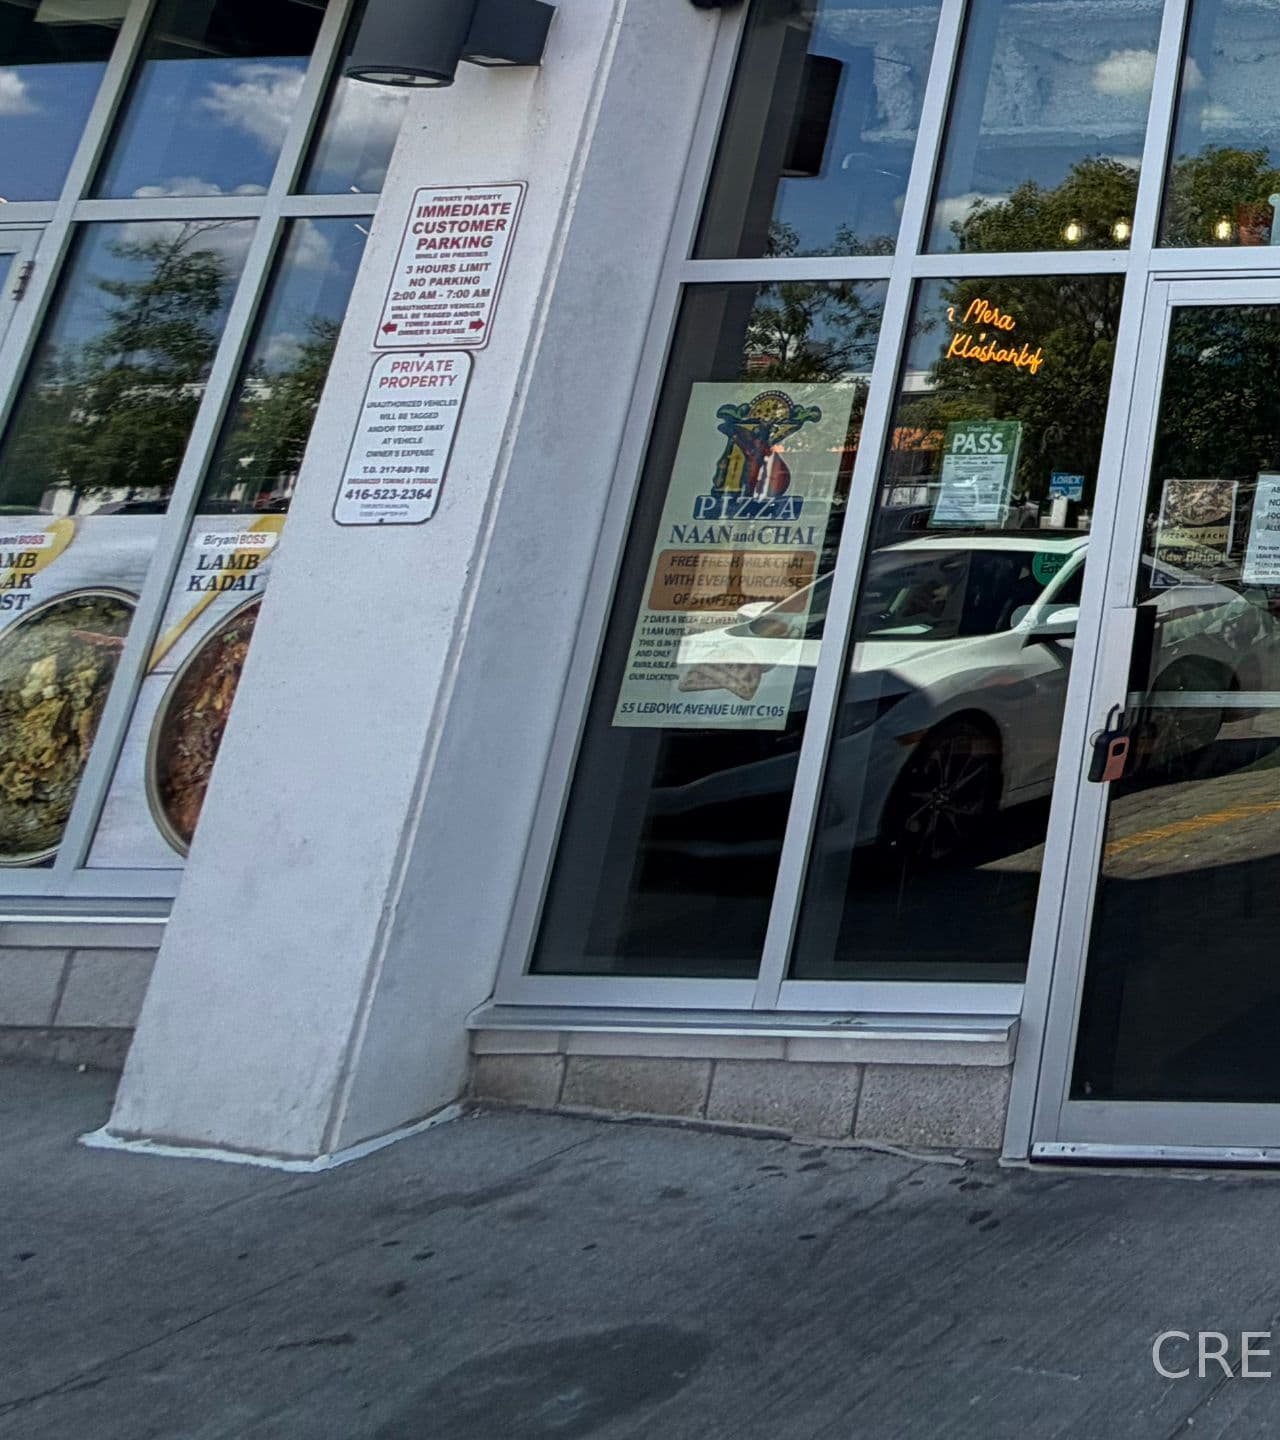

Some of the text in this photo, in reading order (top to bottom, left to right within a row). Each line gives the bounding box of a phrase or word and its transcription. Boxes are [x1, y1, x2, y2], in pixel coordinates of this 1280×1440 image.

[416, 202, 511, 217] IMMEDIATE
[412, 218, 507, 234] CUSTOMER
[416, 235, 493, 250] PARKING
[405, 262, 491, 273] 3 HOURS LIMIT
[409, 276, 479, 286] NO PARKING
[392, 291, 415, 300] 2:00
[418, 290, 436, 299] AM
[446, 289, 470, 298] 7:00
[472, 288, 490, 297] AM
[391, 359, 453, 372] PRIVATE
[379, 374, 457, 388] PROPERTY
[952, 433, 1003, 453] PASS
[344, 489, 432, 499] 416-523-2364
[696, 496, 797, 520] PIZZA
[669, 525, 816, 545] NAAN and CHAI
[0, 552, 38, 569] MB
[196, 554, 260, 570] LAMB
[670, 556, 699, 568] FREE
[701, 556, 740, 568] FRESH
[1041, 563, 1062, 574] Eat
[186, 575, 258, 591] KADAI
[664, 575, 804, 589] WITH EVERY PURCHASE
[0, 594, 31, 610] ST
[673, 593, 688, 605] OF
[620, 702, 785, 717] 55 LEBOVIC AVENUE UNIT C105
